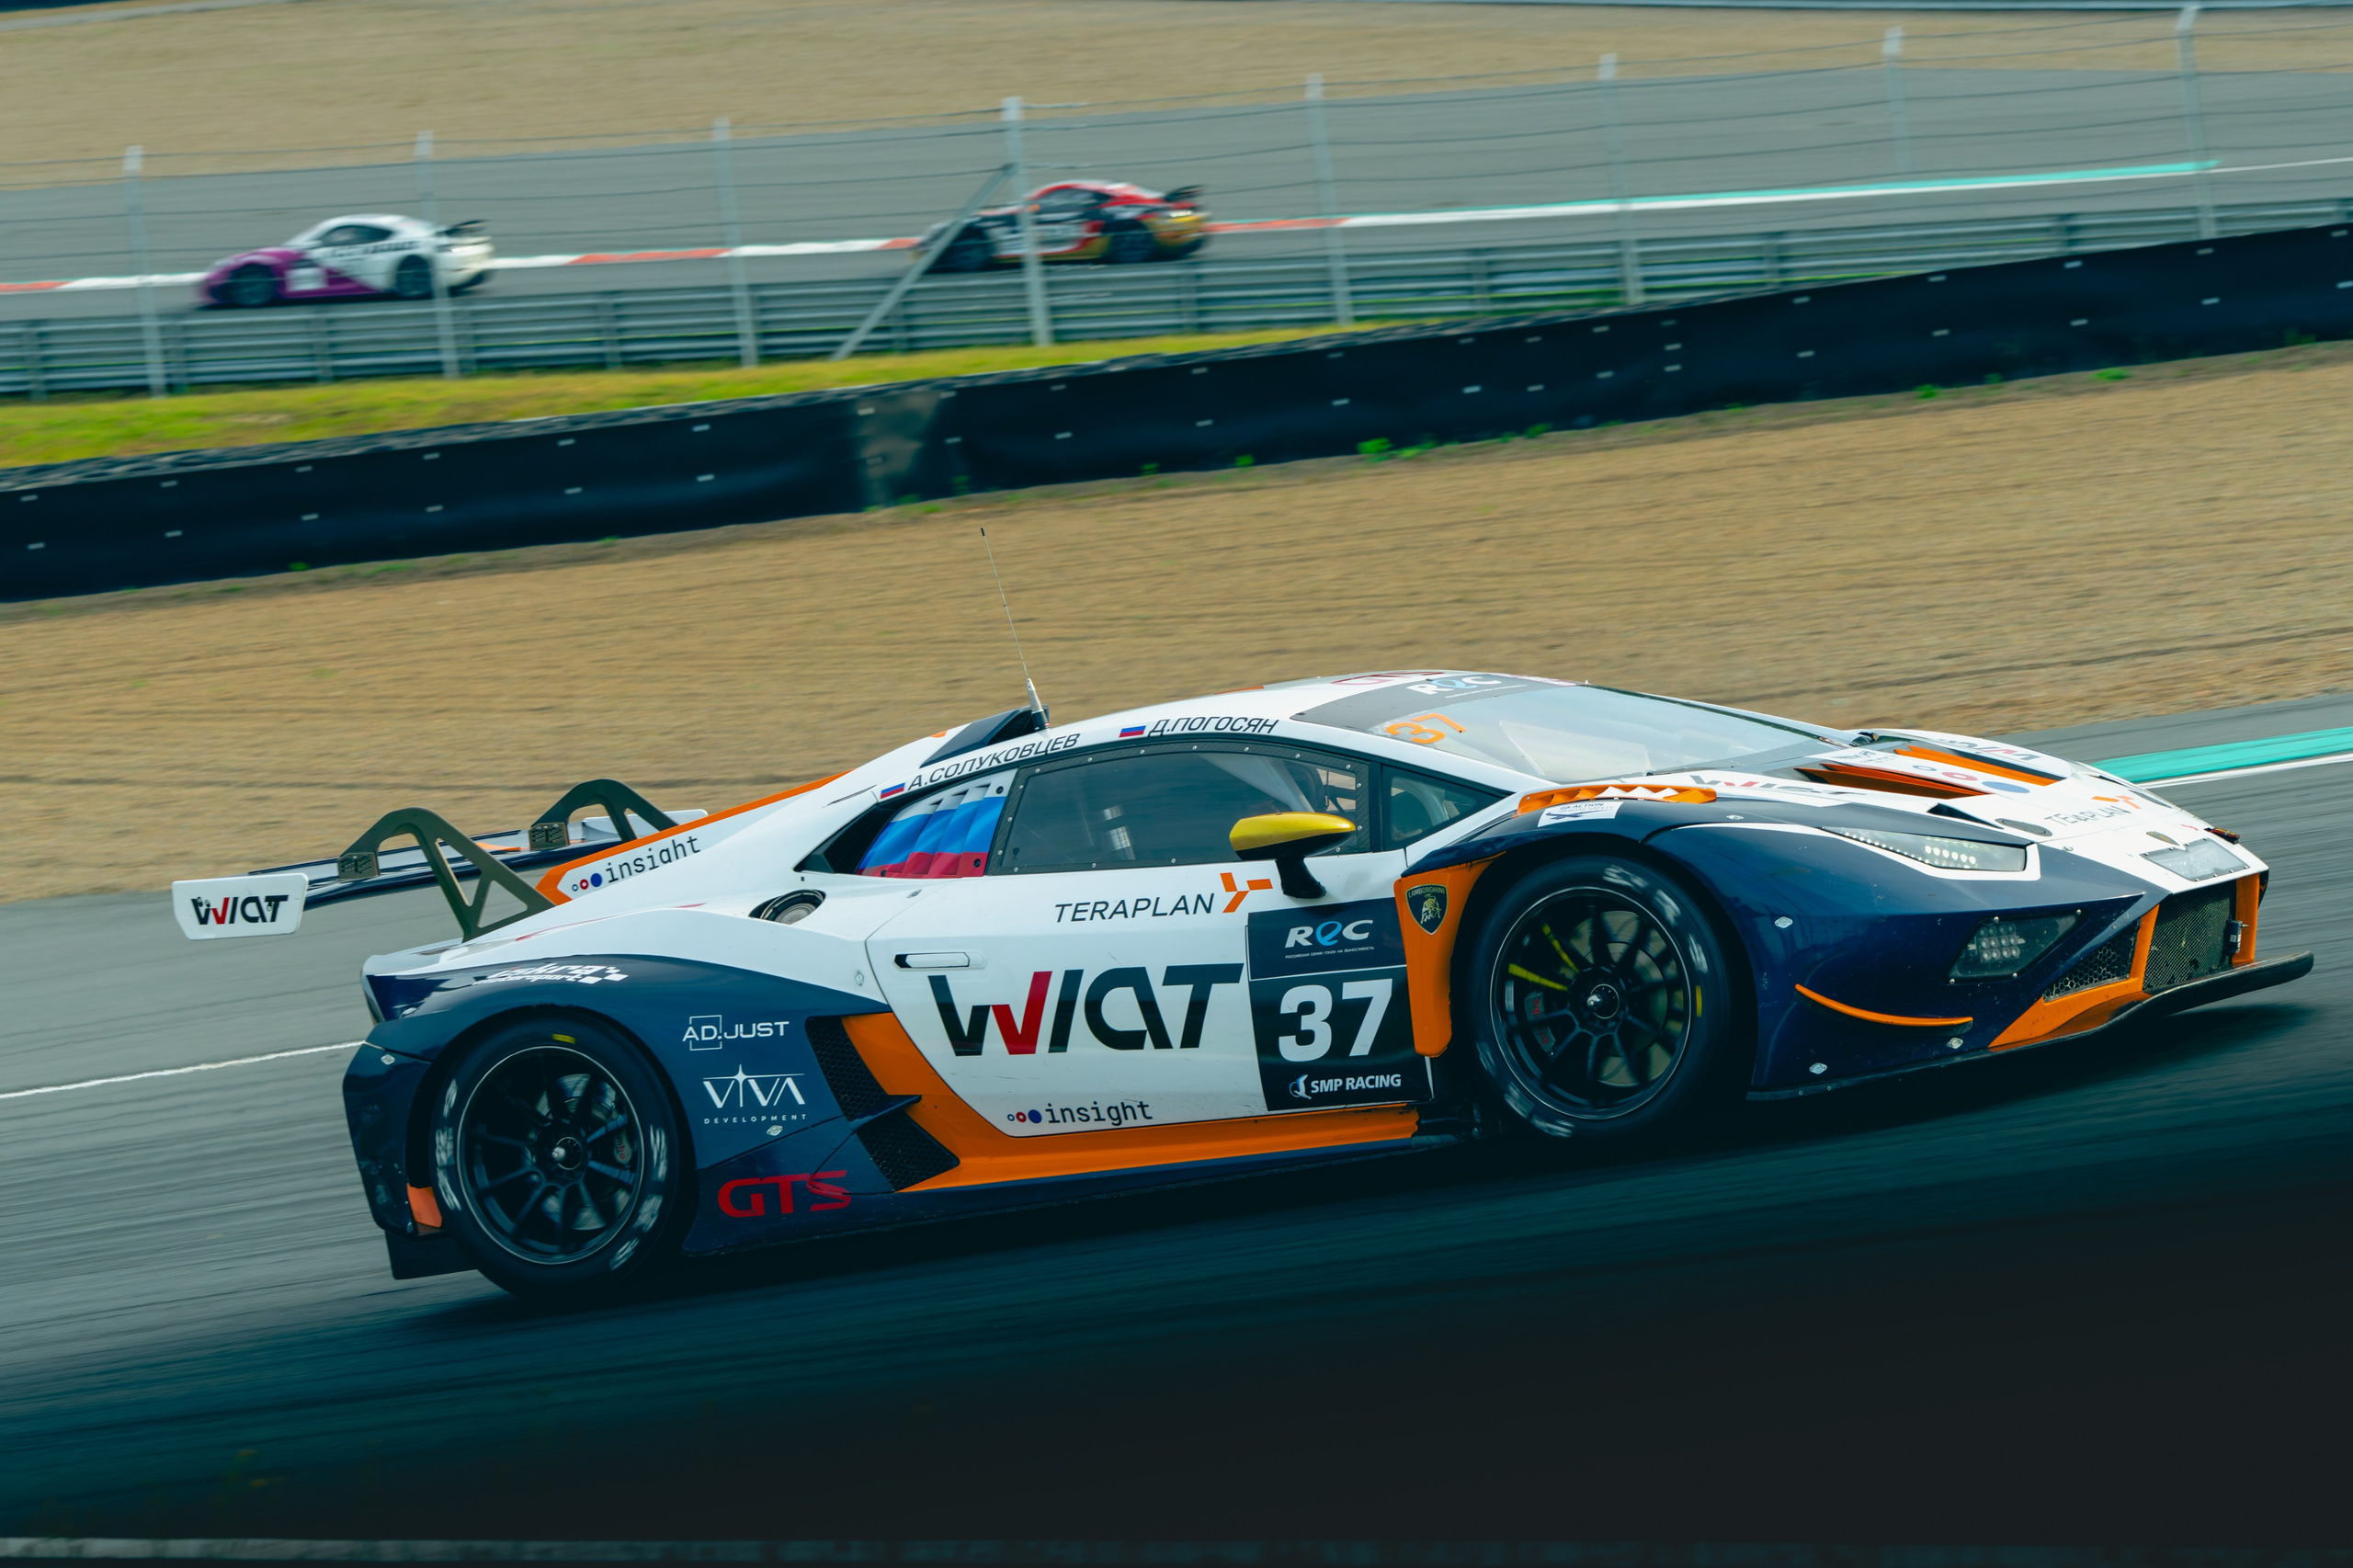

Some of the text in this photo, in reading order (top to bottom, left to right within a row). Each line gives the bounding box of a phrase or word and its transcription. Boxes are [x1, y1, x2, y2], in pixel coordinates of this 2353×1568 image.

[1148, 716, 1279, 736] Д.ПОГОСЯН
[1385, 712, 1467, 744] 37
[907, 733, 1081, 791] А.СОЛУКОВЦЕВ
[605, 835, 701, 883] insight
[1054, 892, 1215, 924] TERAPLAN
[1407, 886, 1446, 898] LAMBORGHINI
[1278, 977, 1393, 1062] 37
[702, 1067, 806, 1108] VIVA
[1310, 1074, 1402, 1094] SMP RACING
[704, 1113, 807, 1125] DEVELOPMENT
[1046, 1100, 1154, 1126] insight
[717, 1169, 852, 1218] GTS
